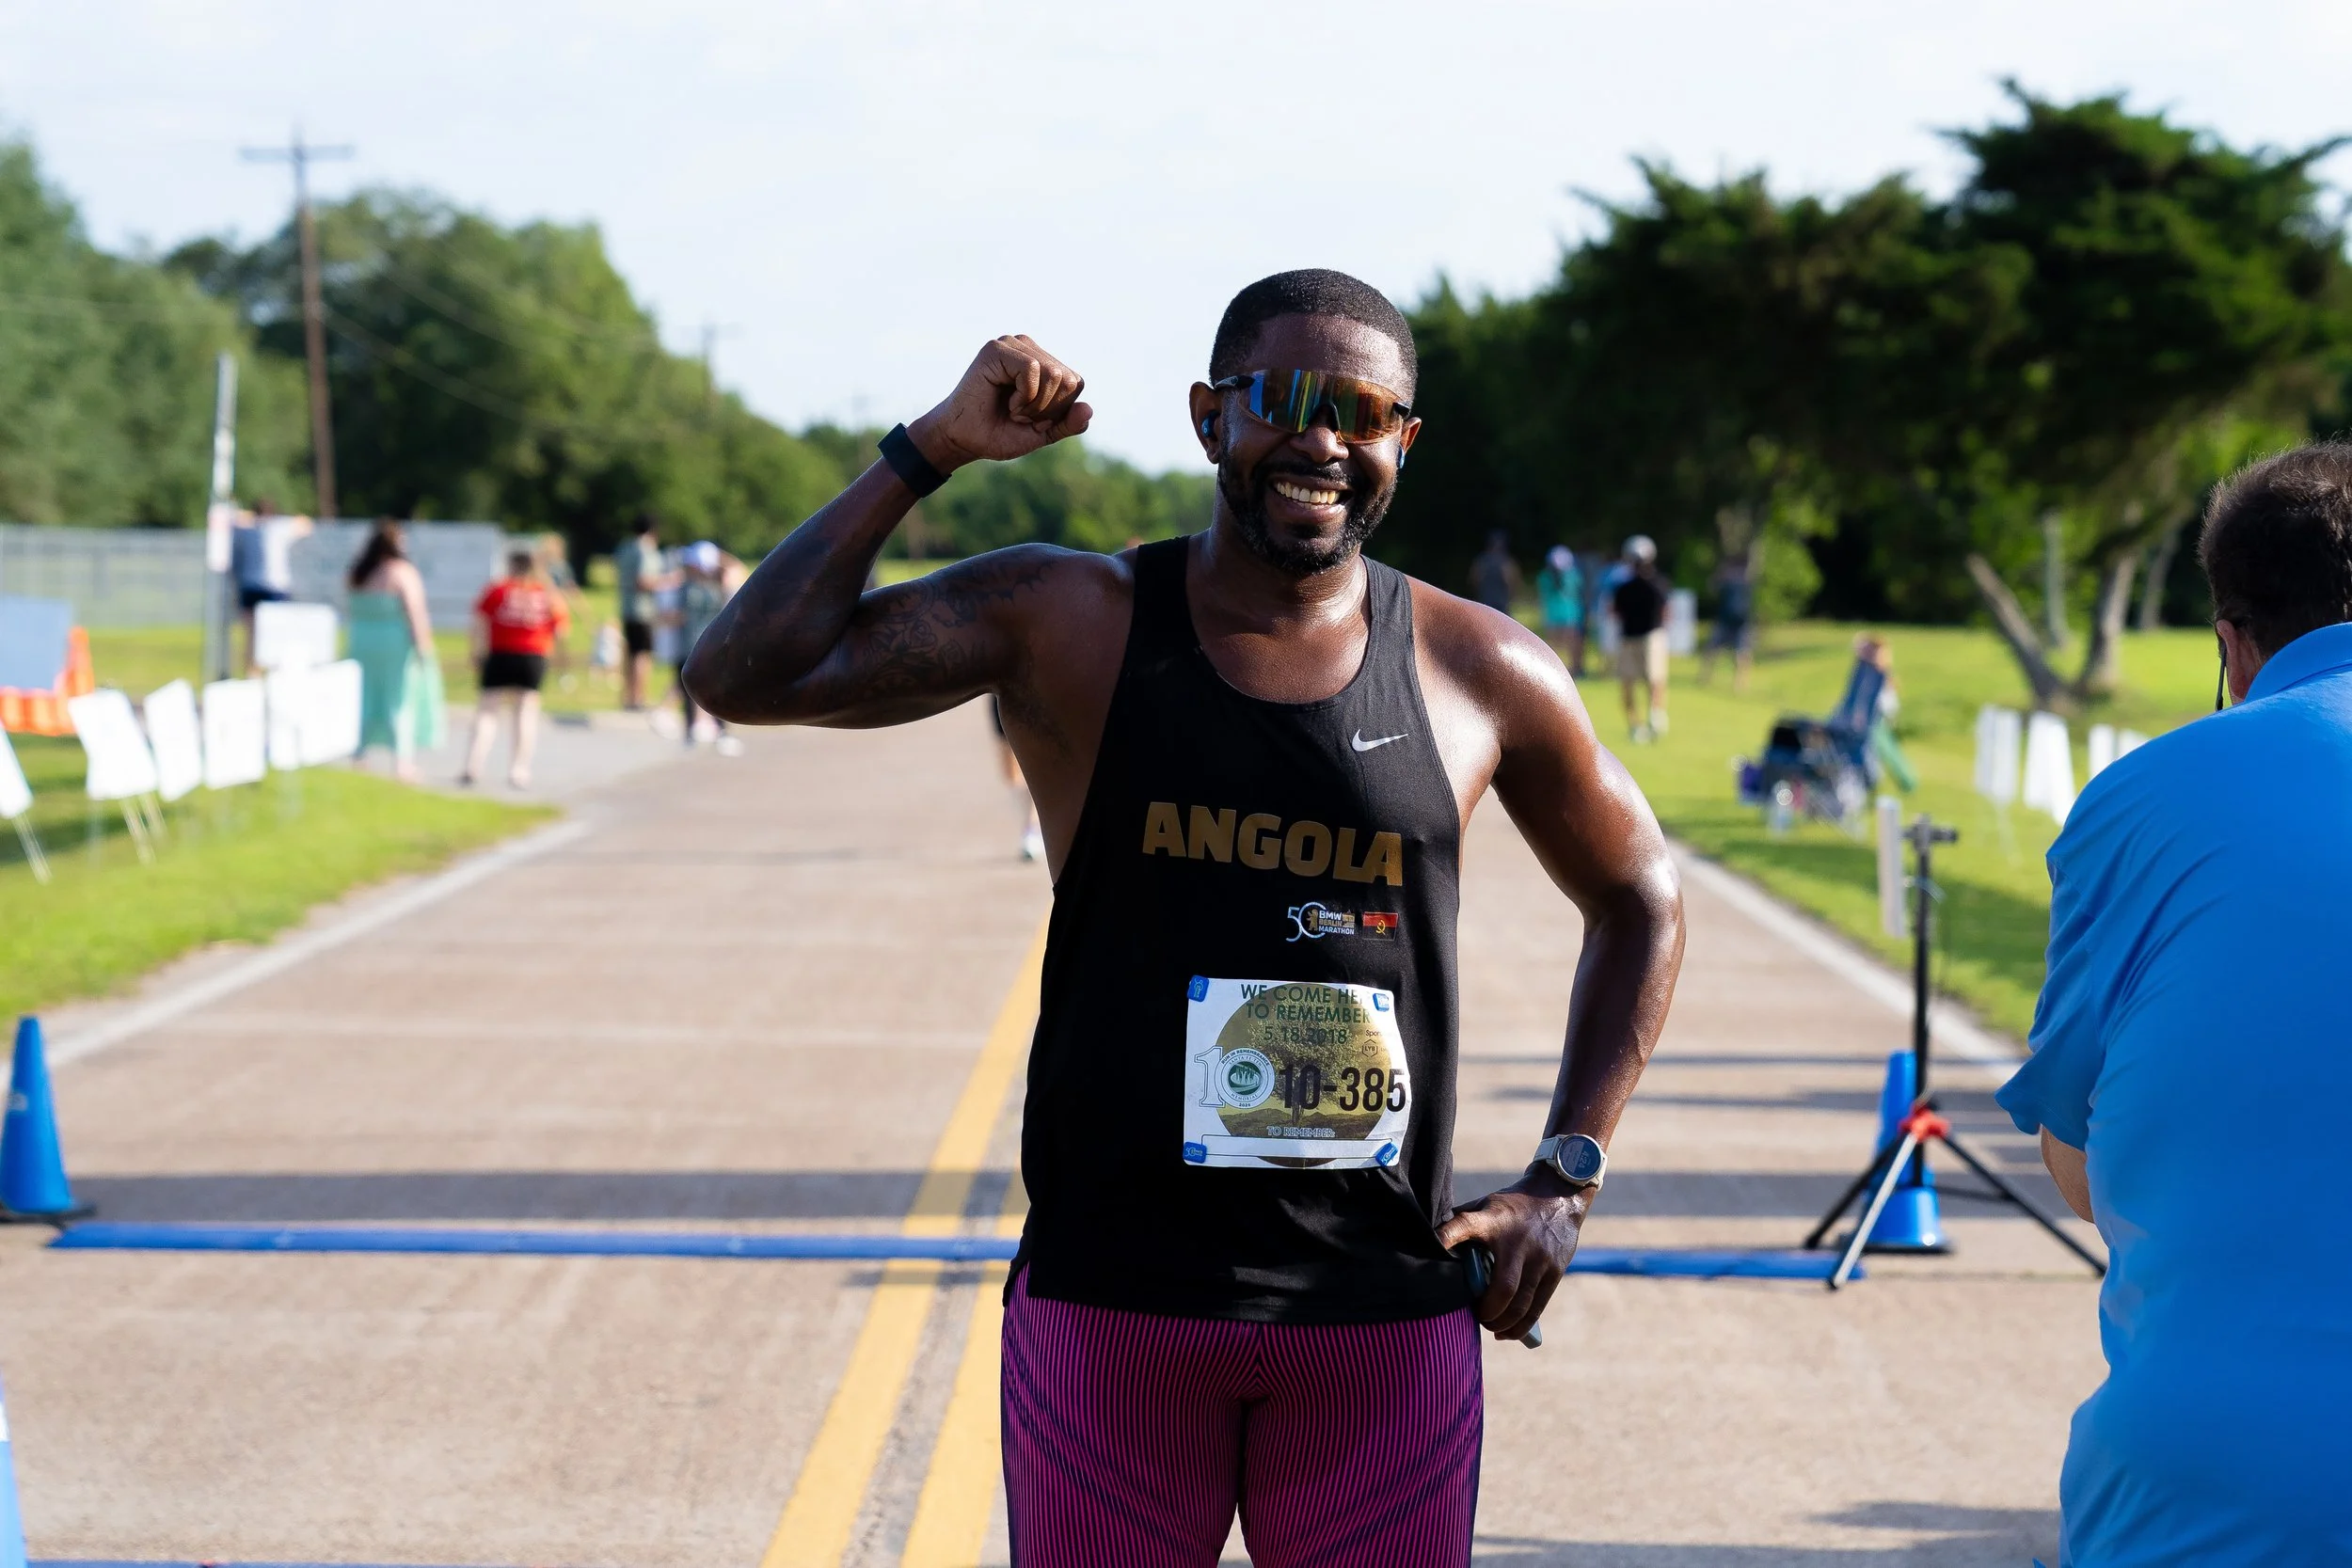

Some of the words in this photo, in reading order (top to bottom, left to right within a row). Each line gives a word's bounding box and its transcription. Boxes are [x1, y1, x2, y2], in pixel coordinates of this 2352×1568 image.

[1142, 801, 1403, 886] ANGOLA
[1318, 910, 1343, 921] BMW
[1318, 918, 1343, 927] BERLIN
[1318, 925, 1355, 935] MARATHON
[1241, 984, 1267, 999] WE
[1274, 986, 1330, 1003] COME
[1338, 989, 1363, 1005] HE
[1246, 1003, 1269, 1020] TO
[1277, 1005, 1371, 1023] REMEMBER
[1279, 1064, 1406, 1112] 10-385
[1266, 1126, 1281, 1136] TO
